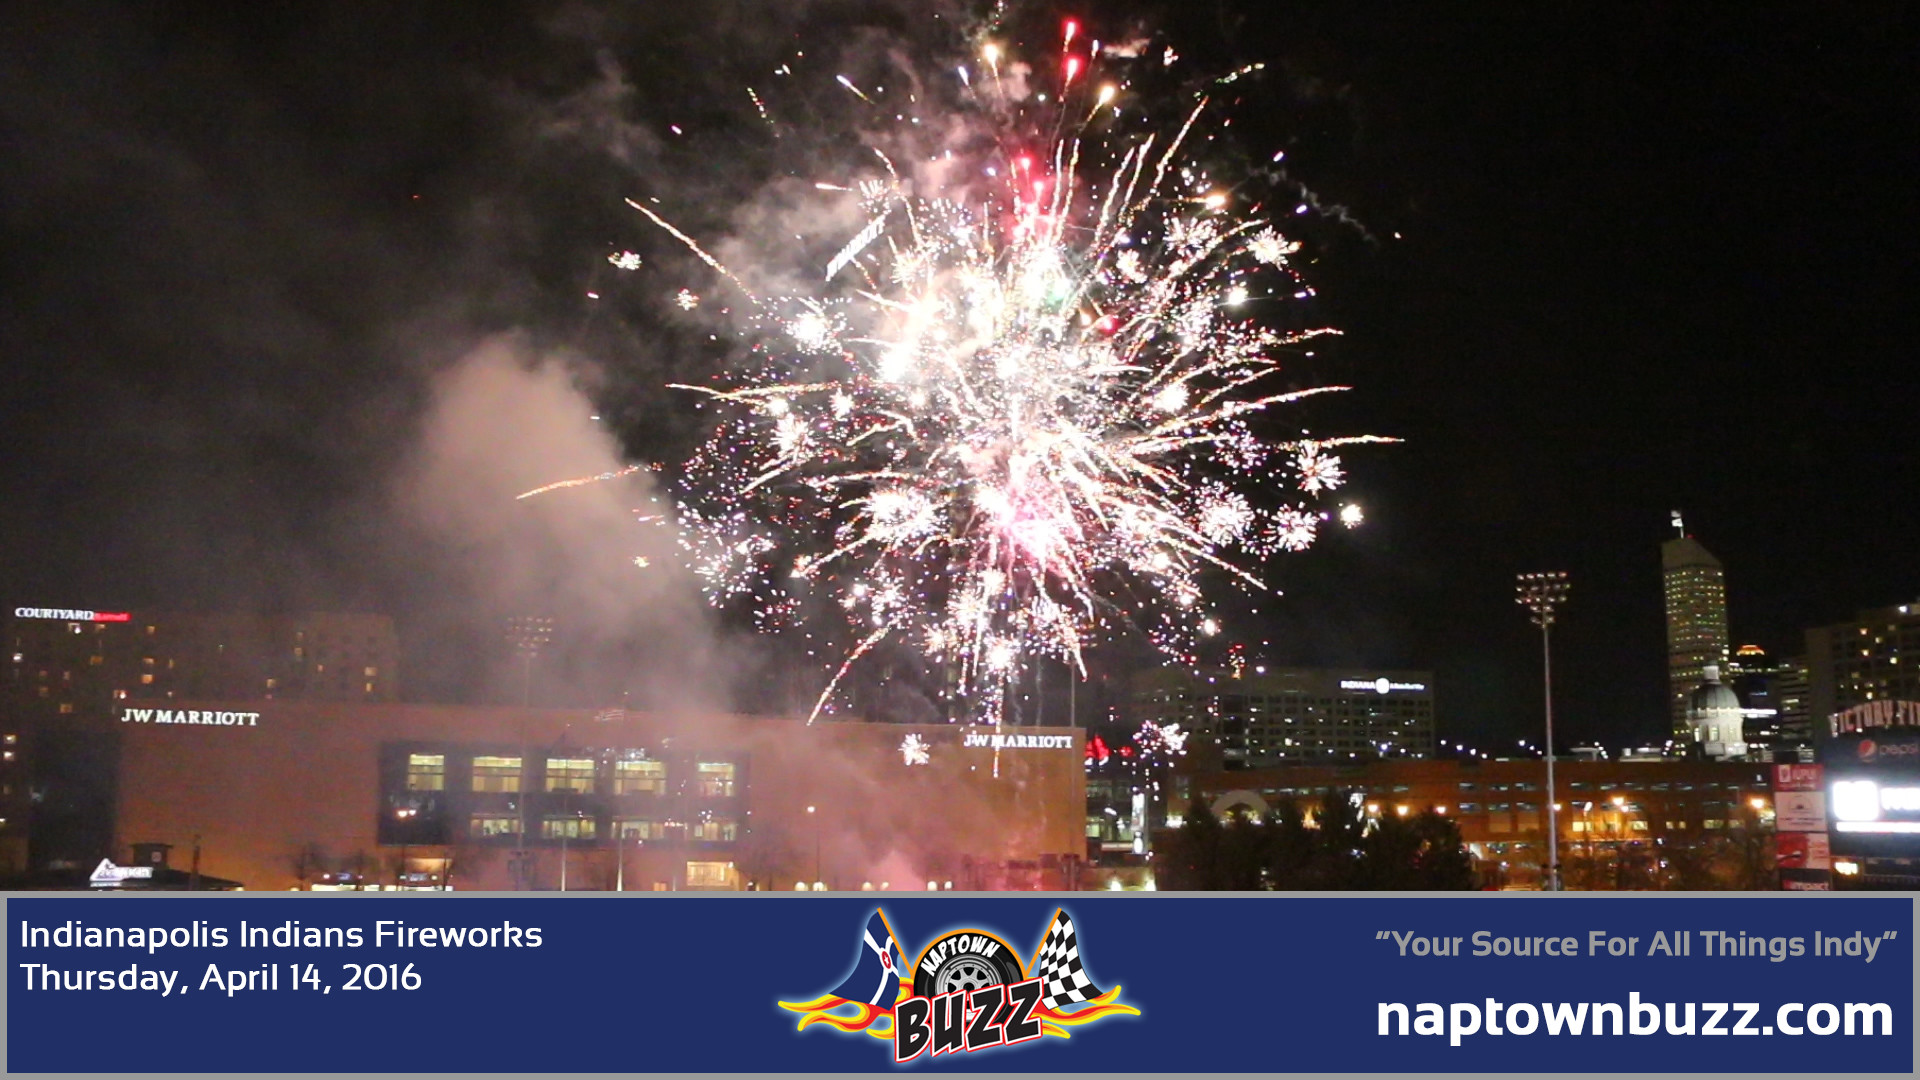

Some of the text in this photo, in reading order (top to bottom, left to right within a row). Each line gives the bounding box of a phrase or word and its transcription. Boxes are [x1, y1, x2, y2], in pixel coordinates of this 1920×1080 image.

[15, 607, 95, 621] COURTYARD
[121, 708, 260, 726] JW MARRIOTT
[964, 734, 1073, 749] JW MARRIOTT
